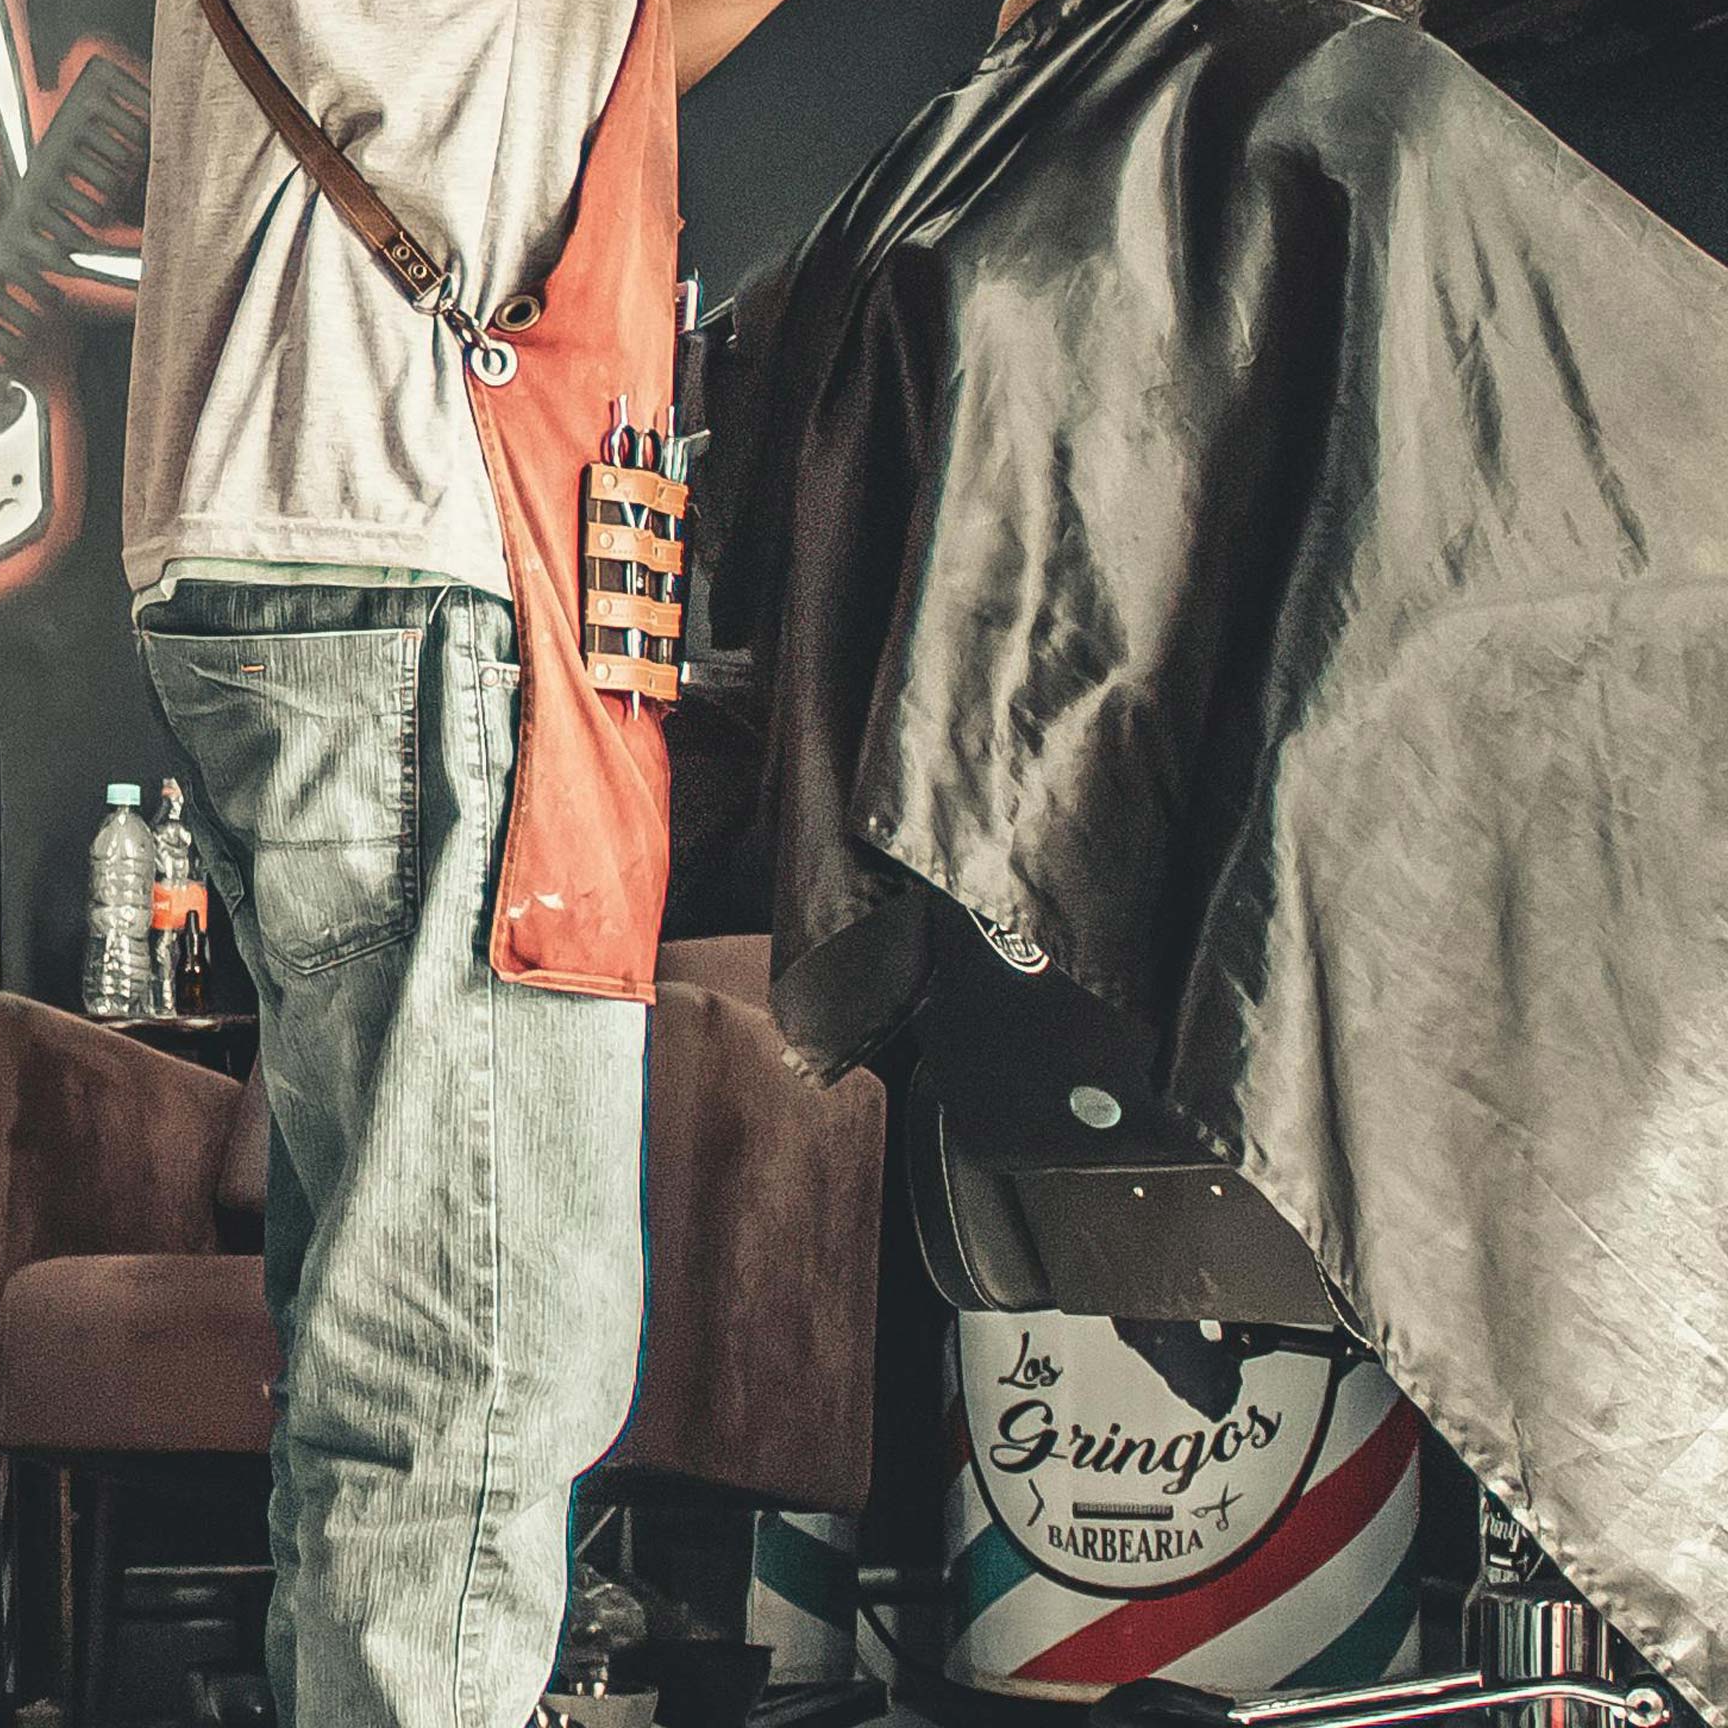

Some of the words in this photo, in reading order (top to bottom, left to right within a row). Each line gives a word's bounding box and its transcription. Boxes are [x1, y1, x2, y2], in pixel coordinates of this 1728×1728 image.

[998, 1331, 1064, 1390] Los
[989, 1399, 1282, 1494] Gringos
[1048, 1525, 1204, 1563] BARBEARIA
